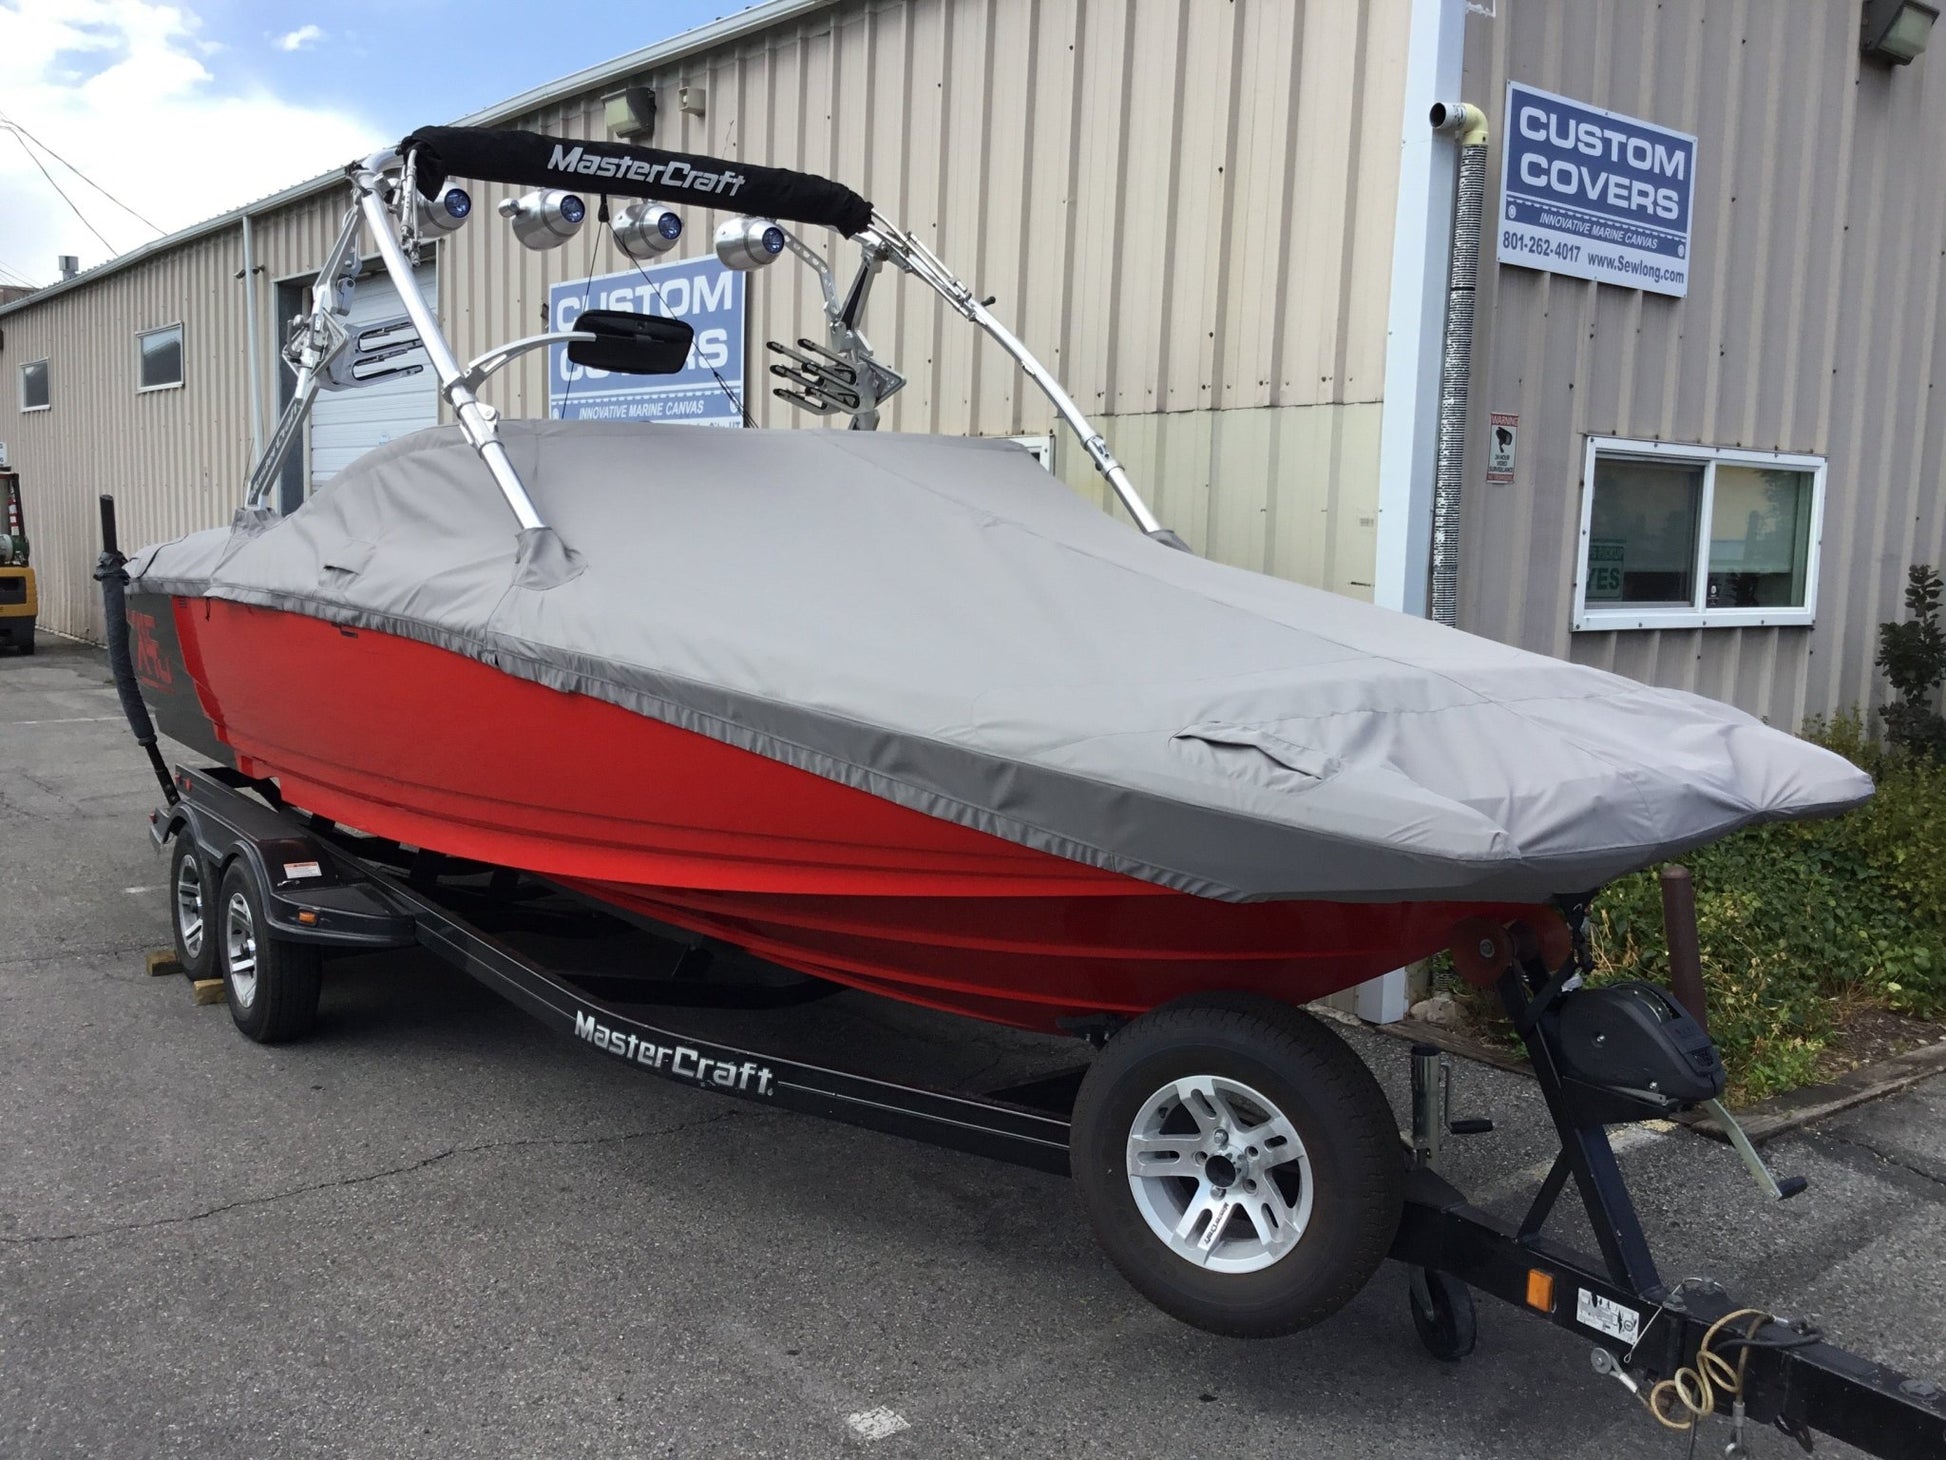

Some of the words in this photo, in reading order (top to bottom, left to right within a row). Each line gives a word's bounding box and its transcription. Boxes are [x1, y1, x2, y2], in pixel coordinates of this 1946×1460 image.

[1519, 105, 1686, 181] CUSTOM
[547, 144, 746, 197] MasterCraft
[1519, 152, 1679, 220] COVERS
[1539, 212, 1591, 234] INNOVATIVE
[1591, 225, 1624, 242] MARINE
[1625, 232, 1658, 249] CANVAS
[1502, 231, 1582, 263] 801-262-4017
[1587, 252, 1685, 284] www.Sewlong.com
[579, 403, 627, 419] INNOVATIVE
[628, 401, 663, 418] MARINE
[665, 399, 705, 415] CANVAS
[574, 1010, 773, 1095] MasterCraft
